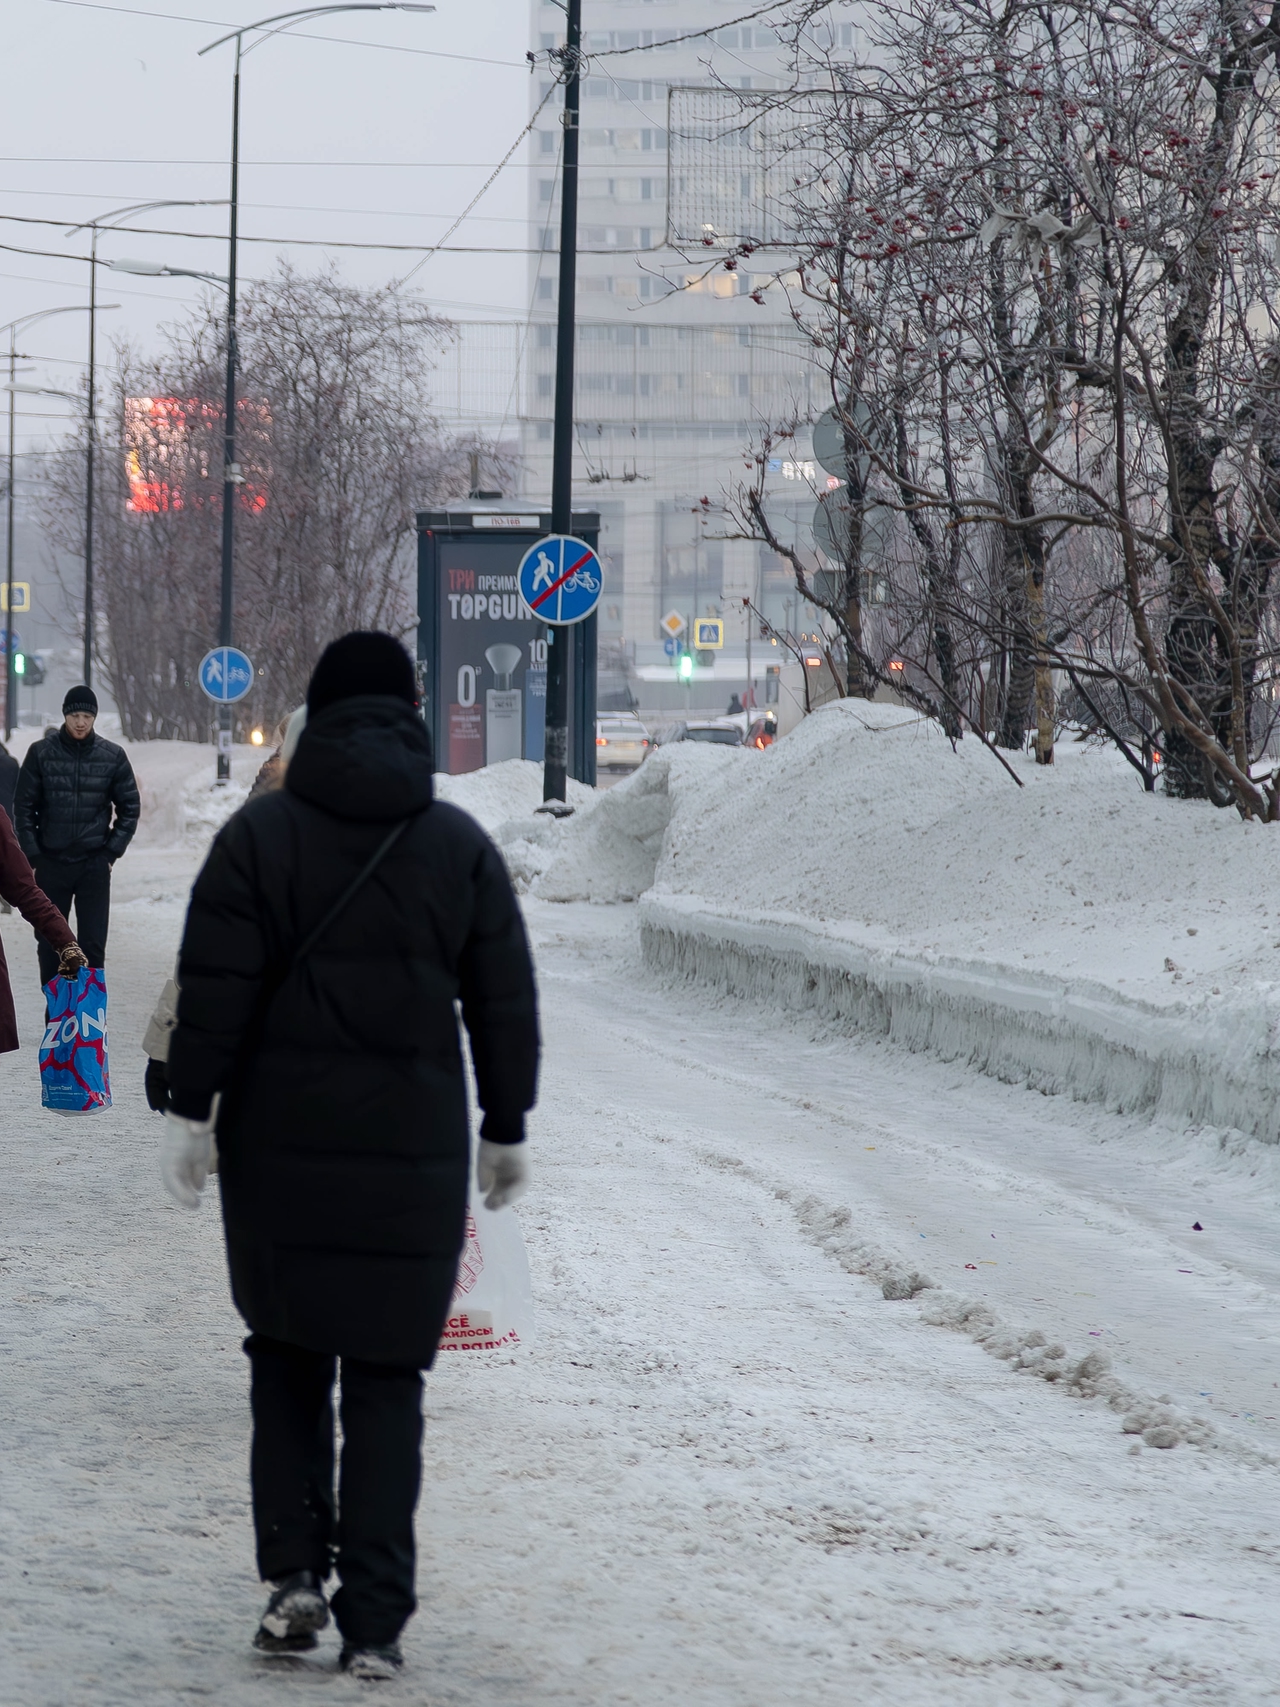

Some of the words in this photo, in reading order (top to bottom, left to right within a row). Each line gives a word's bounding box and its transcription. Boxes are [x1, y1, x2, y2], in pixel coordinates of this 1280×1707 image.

[448, 569, 474, 592] ТРИ
[478, 575, 519, 592] ПРЕИМУ
[445, 1314, 470, 1329] СЁ
